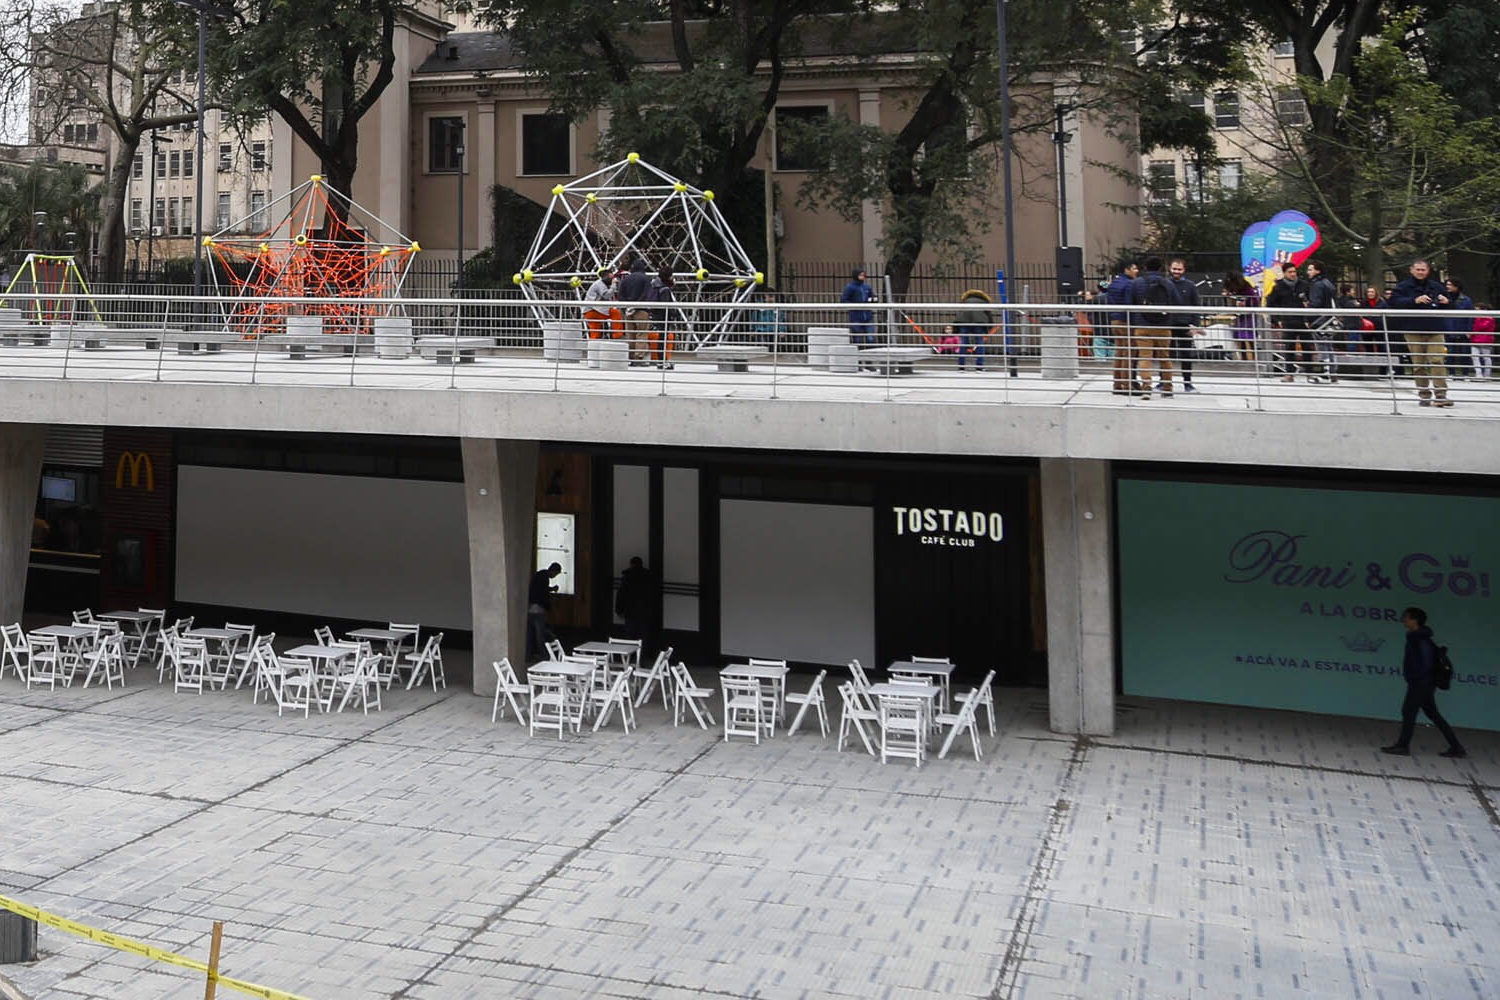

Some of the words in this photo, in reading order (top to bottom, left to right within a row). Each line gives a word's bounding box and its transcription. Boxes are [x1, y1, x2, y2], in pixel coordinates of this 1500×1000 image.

[893, 507, 1004, 542] TOSTADO
[921, 535, 946, 545] CAFÉ
[949, 538, 975, 547] CLUB
[1223, 530, 1357, 589] Pani
[1366, 562, 1392, 591] &
[1300, 601, 1313, 615] A
[1319, 602, 1346, 618] LA
[1352, 606, 1404, 623] OBR
[1278, 657, 1299, 669] VA
[1301, 660, 1310, 670] A
[1315, 661, 1363, 673] ESTAR
[1365, 664, 1386, 676] TU
